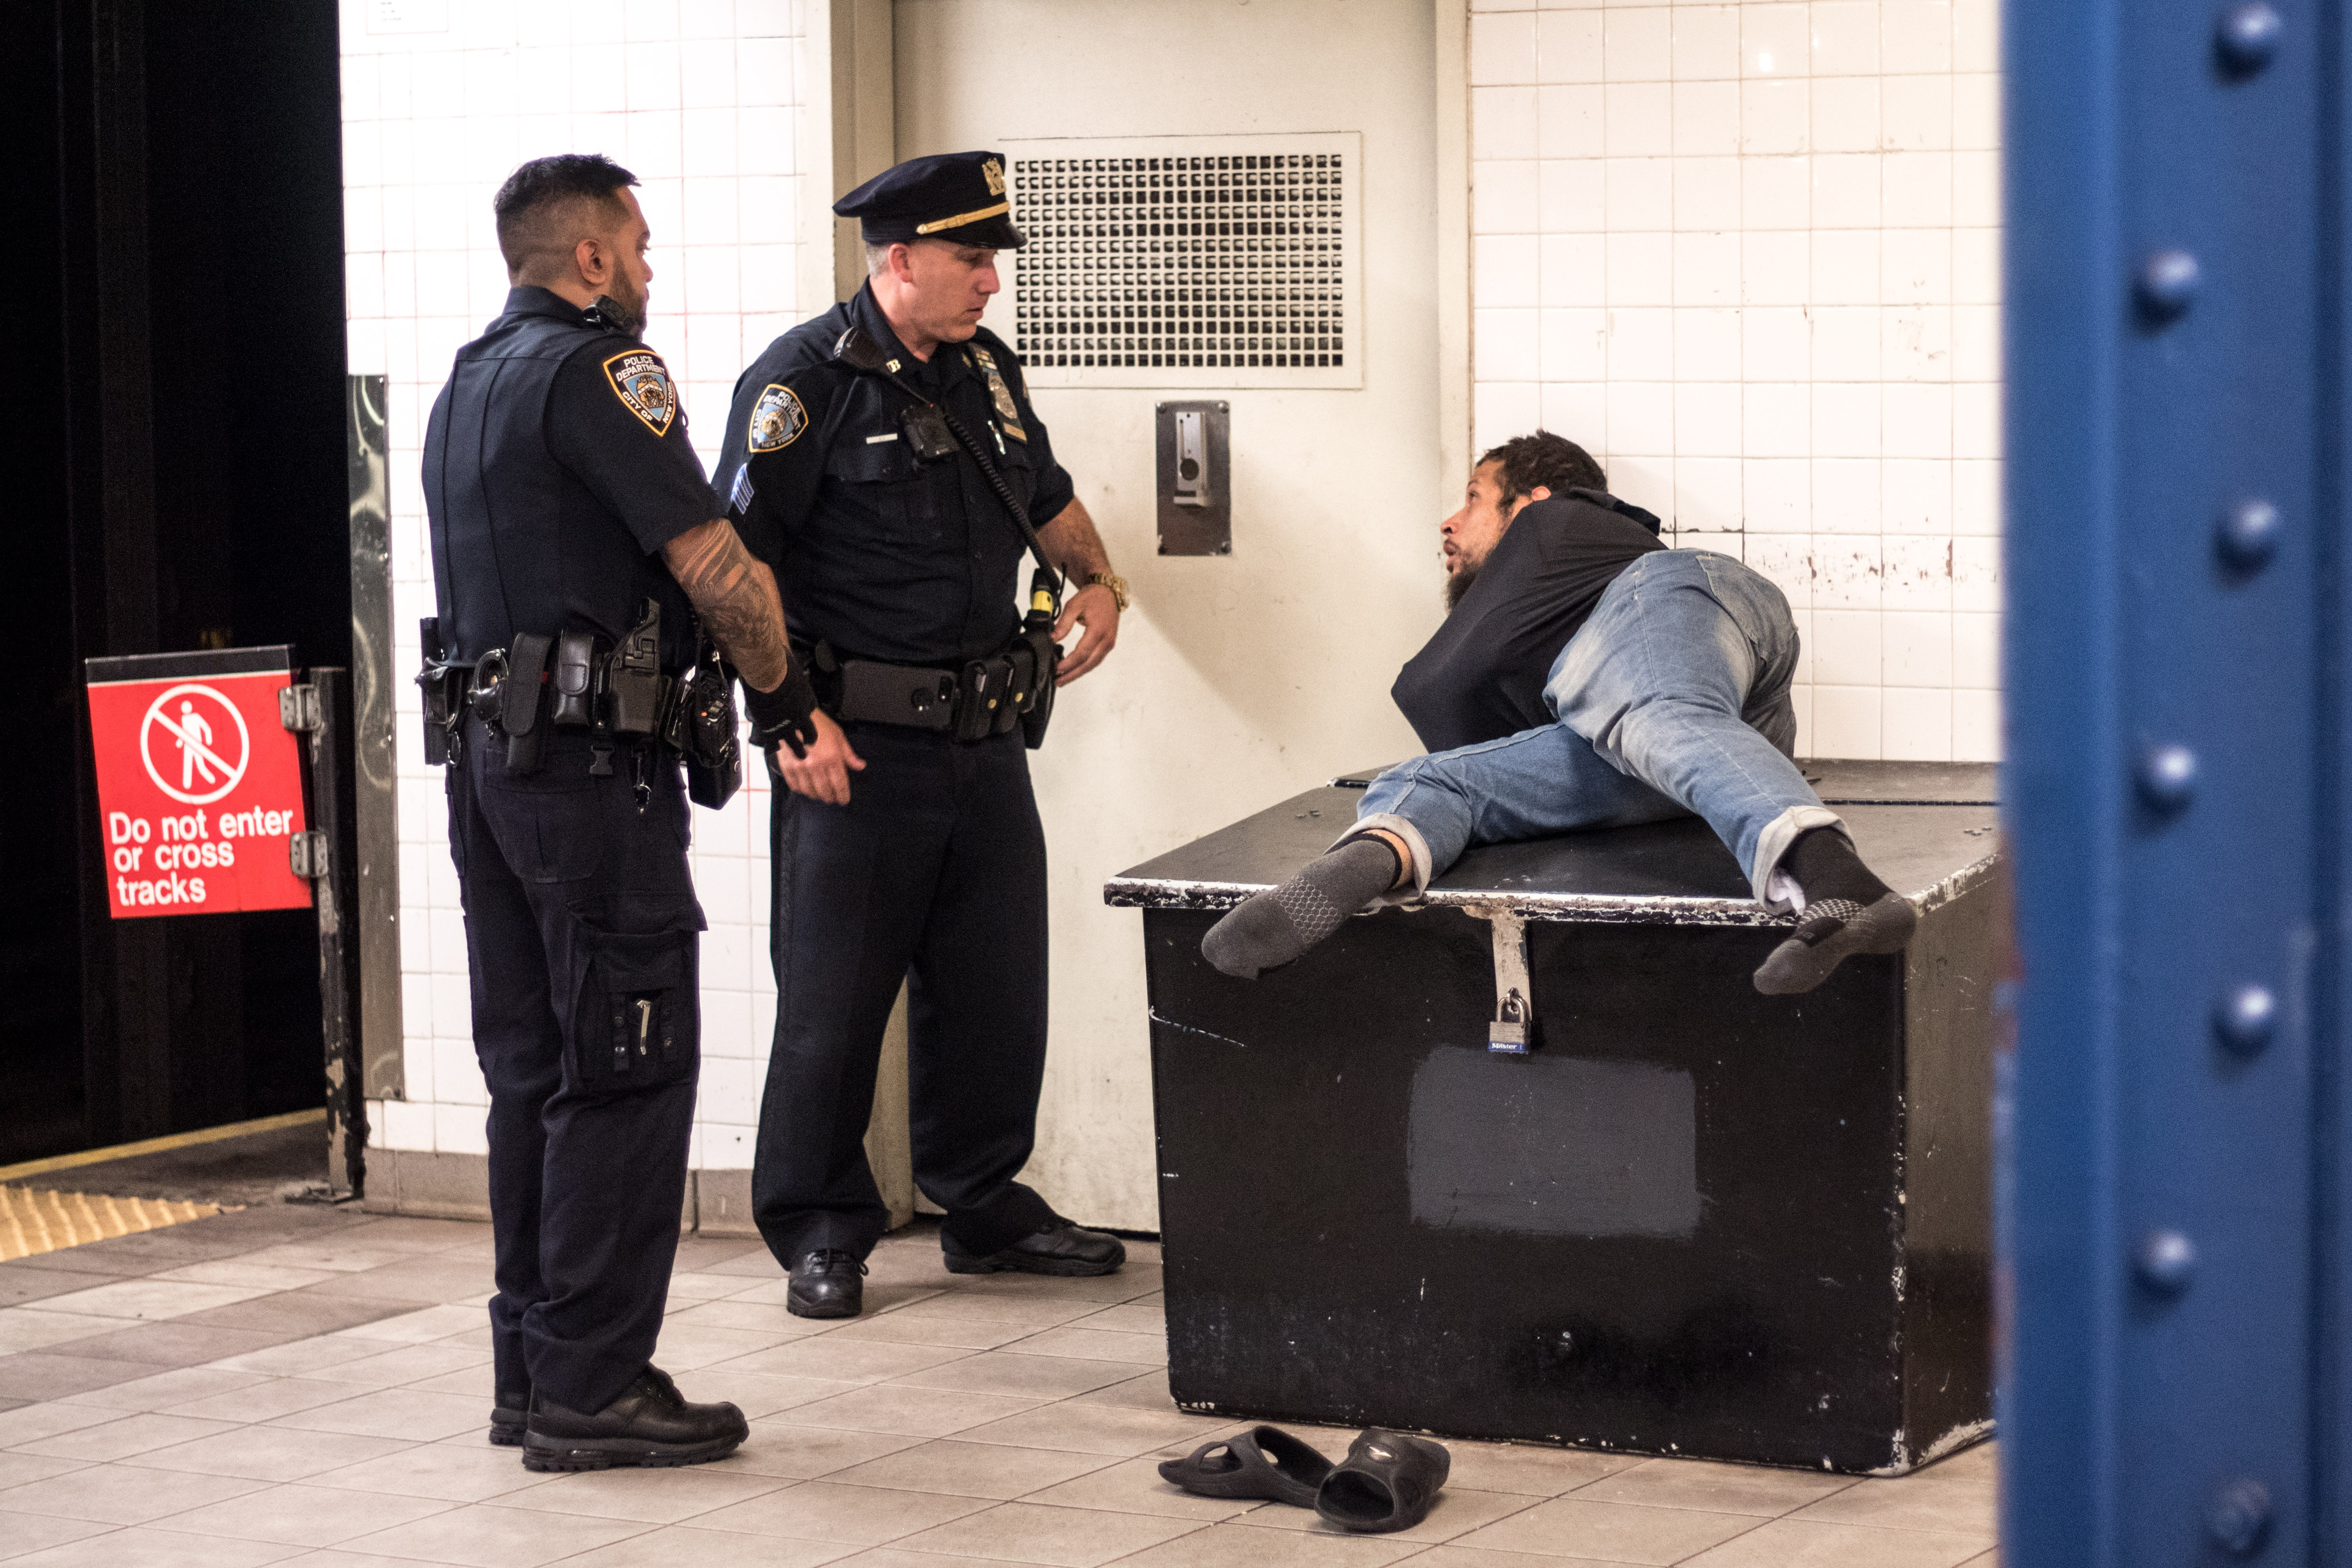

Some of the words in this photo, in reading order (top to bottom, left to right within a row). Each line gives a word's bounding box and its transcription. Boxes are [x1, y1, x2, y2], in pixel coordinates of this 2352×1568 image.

[616, 364, 665, 382] DEPARTMENT
[624, 356, 654, 368] POLICE
[622, 391, 641, 410] CITY
[641, 410, 653, 421] OF
[662, 405, 673, 424] NEW
[109, 812, 151, 844] Do
[161, 809, 209, 841] not
[220, 805, 293, 839] enter
[113, 845, 143, 872] or
[155, 841, 234, 870] cross
[117, 871, 206, 906] tracks
